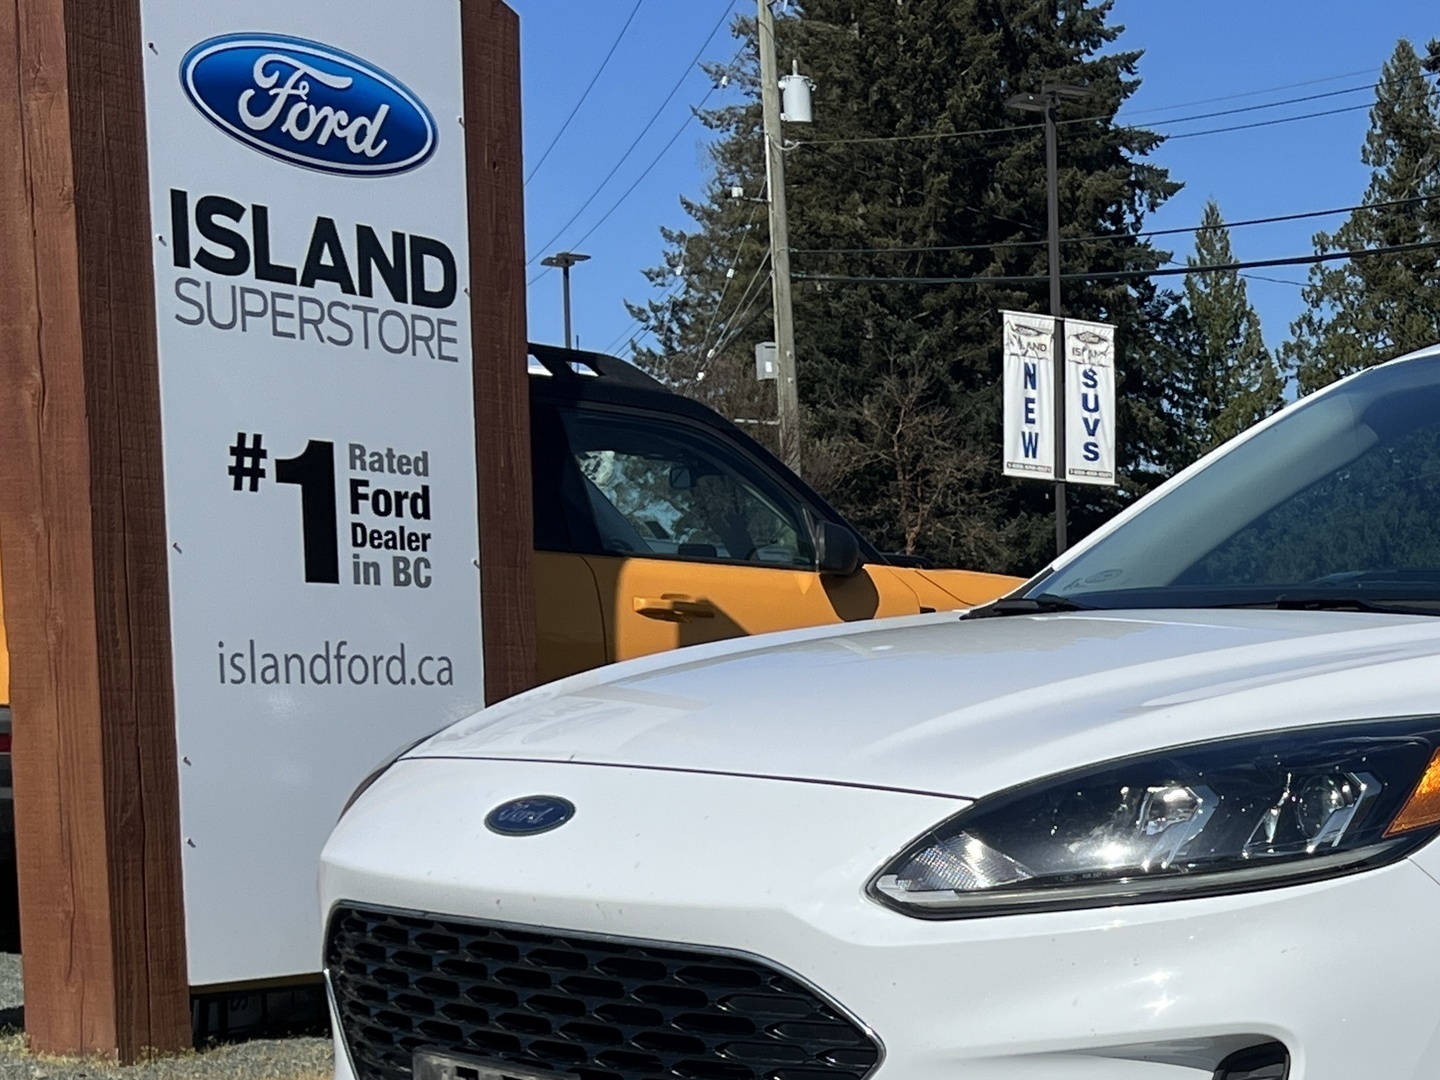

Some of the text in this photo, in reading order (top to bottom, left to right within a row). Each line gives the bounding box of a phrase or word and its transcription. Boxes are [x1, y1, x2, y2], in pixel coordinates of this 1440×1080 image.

[238, 54, 390, 158] Ford
[170, 188, 458, 309] ISLAND
[174, 277, 458, 362] SUPERSTORE
[1022, 363, 1039, 459] NEW
[1082, 368, 1100, 461] SUVS
[348, 443, 429, 477] Rated
[349, 478, 431, 520] Ford
[228, 432, 339, 584] #1
[351, 523, 431, 552] Dealer
[352, 554, 432, 588] in BC
[218, 639, 454, 686] islandford.ca
